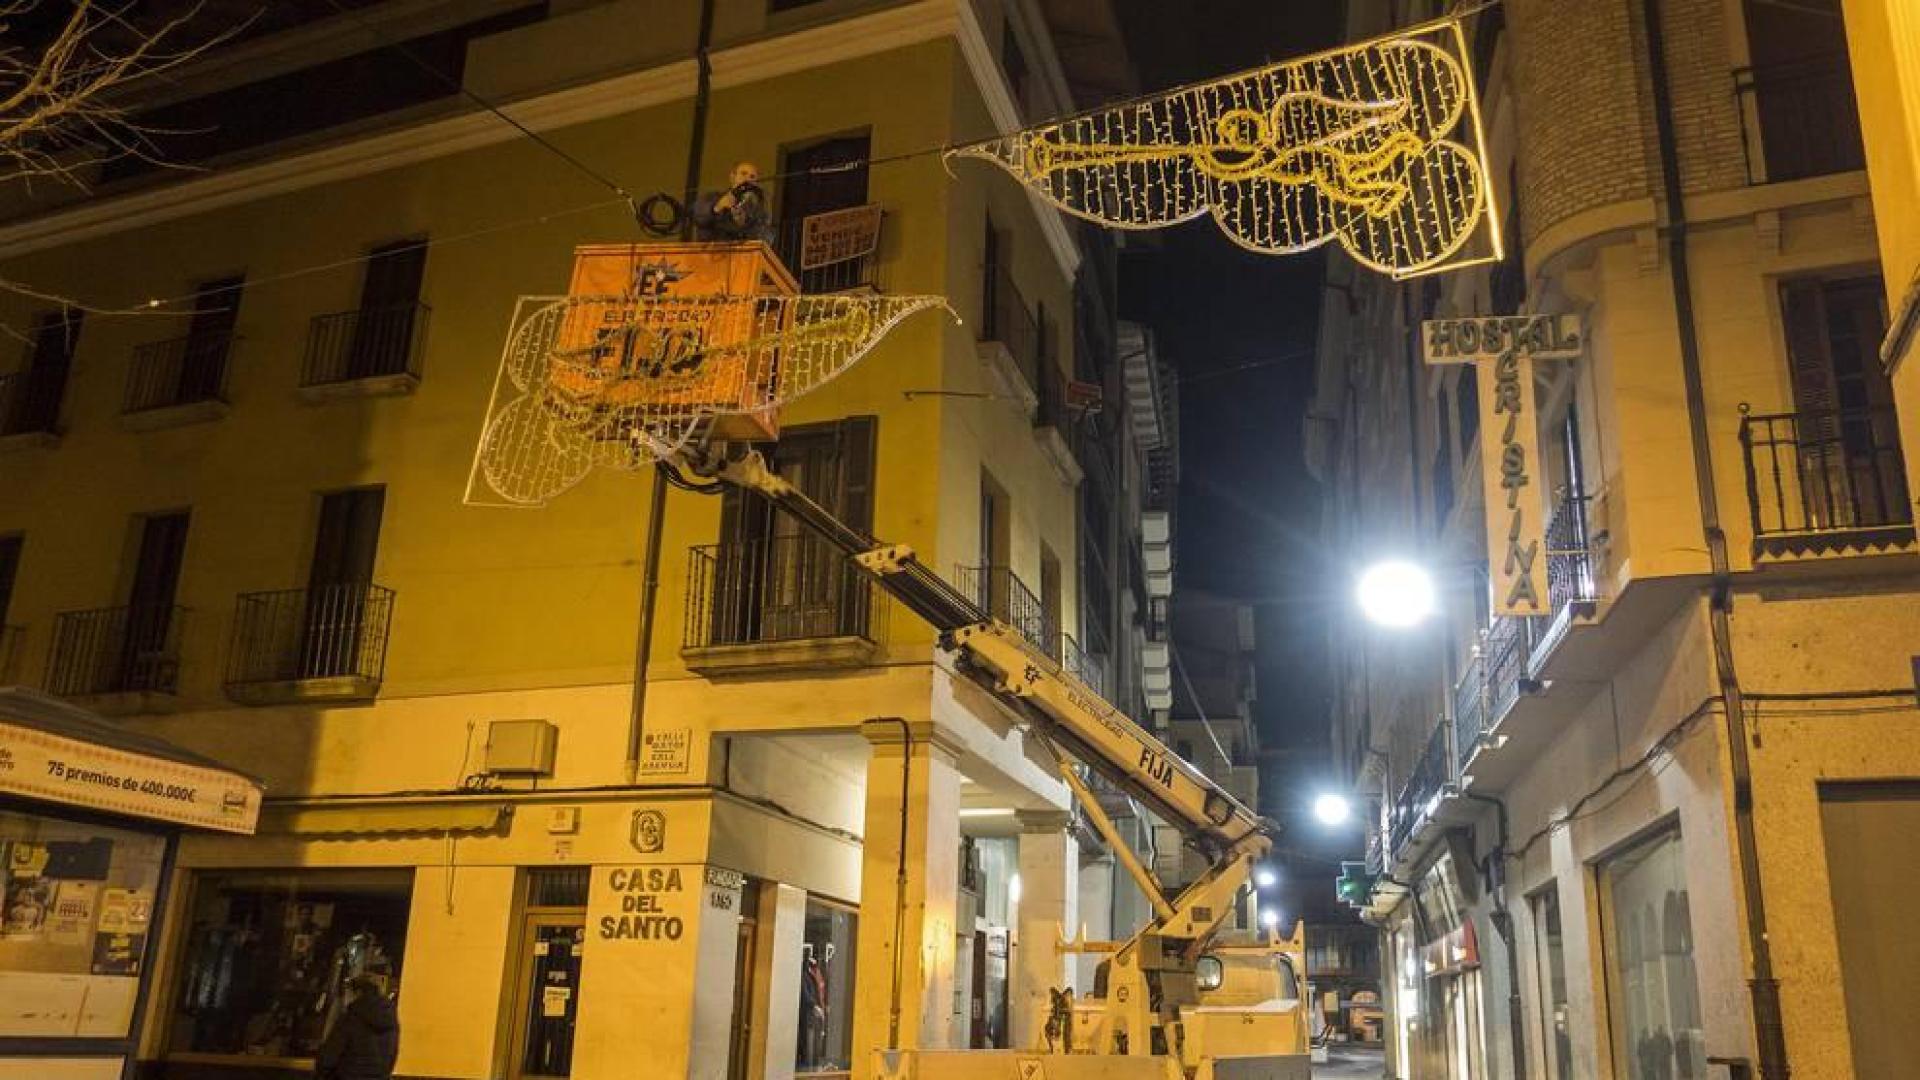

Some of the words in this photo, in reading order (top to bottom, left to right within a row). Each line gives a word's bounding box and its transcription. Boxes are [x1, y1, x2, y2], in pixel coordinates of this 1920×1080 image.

[1429, 315, 1579, 357] HOSTAL
[1493, 351, 1539, 610] CRISTINA
[48, 760, 64, 776] 75
[65, 767, 121, 789] premios
[122, 779, 138, 792] de
[140, 780, 195, 803] 400.000€
[1140, 743, 1173, 788] FIJA
[609, 868, 683, 893] CASA
[622, 895, 664, 914] DEL
[600, 916, 684, 941] SANTO
